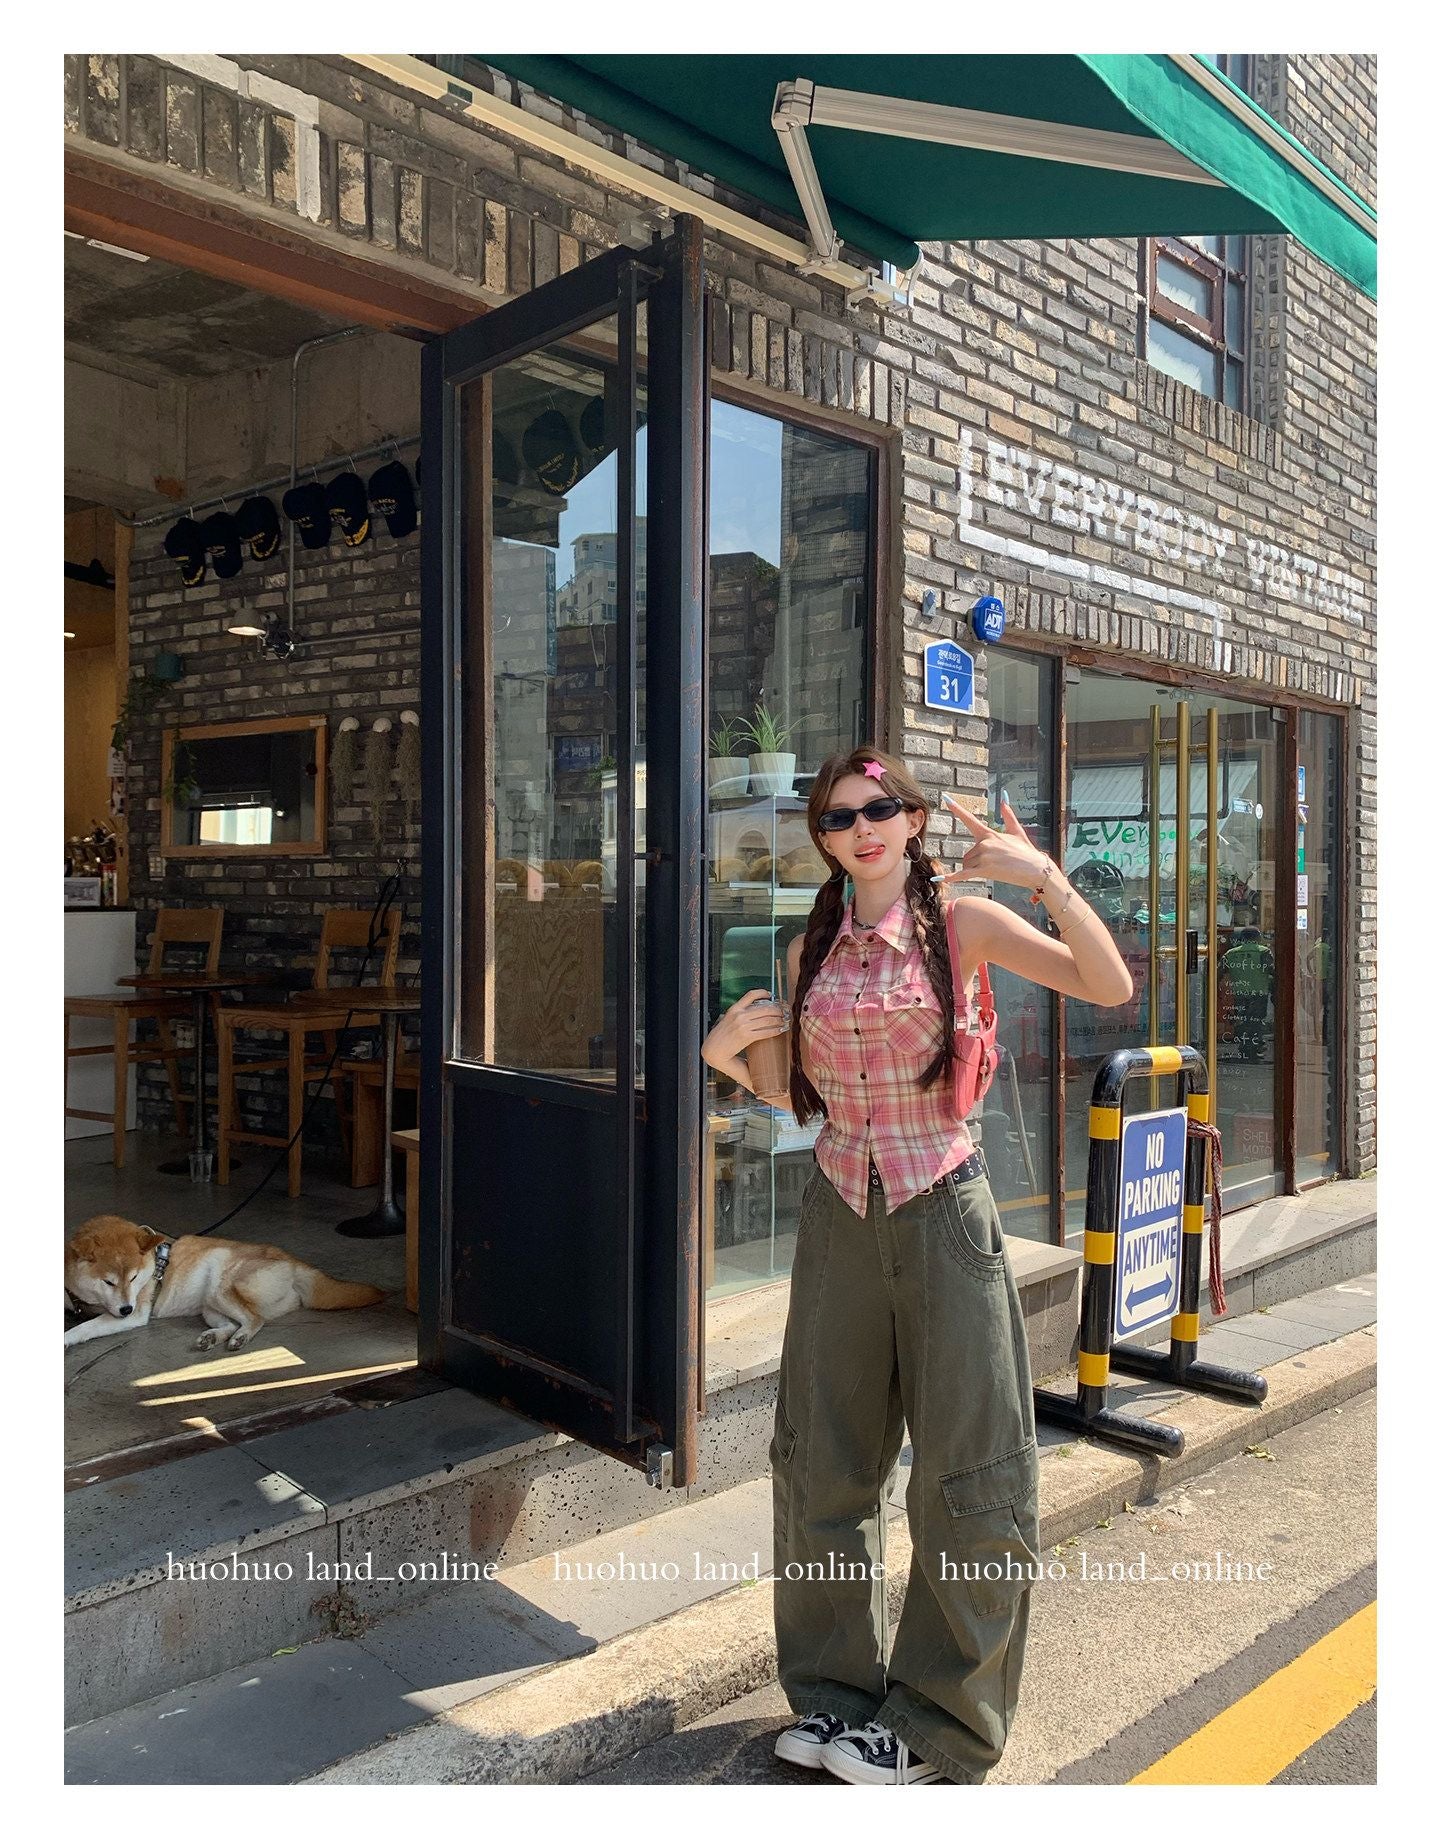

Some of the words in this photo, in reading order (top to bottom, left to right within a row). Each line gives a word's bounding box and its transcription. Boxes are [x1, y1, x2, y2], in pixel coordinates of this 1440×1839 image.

[986, 442, 1235, 576] EVERYBODY
[985, 614, 1003, 629] ADT
[940, 675, 959, 703] 31
[1221, 1031, 1260, 1046] Café
[1146, 1132, 1164, 1171] NO
[1124, 1170, 1180, 1220] PARKING
[1124, 1225, 1177, 1275] ANYTIME
